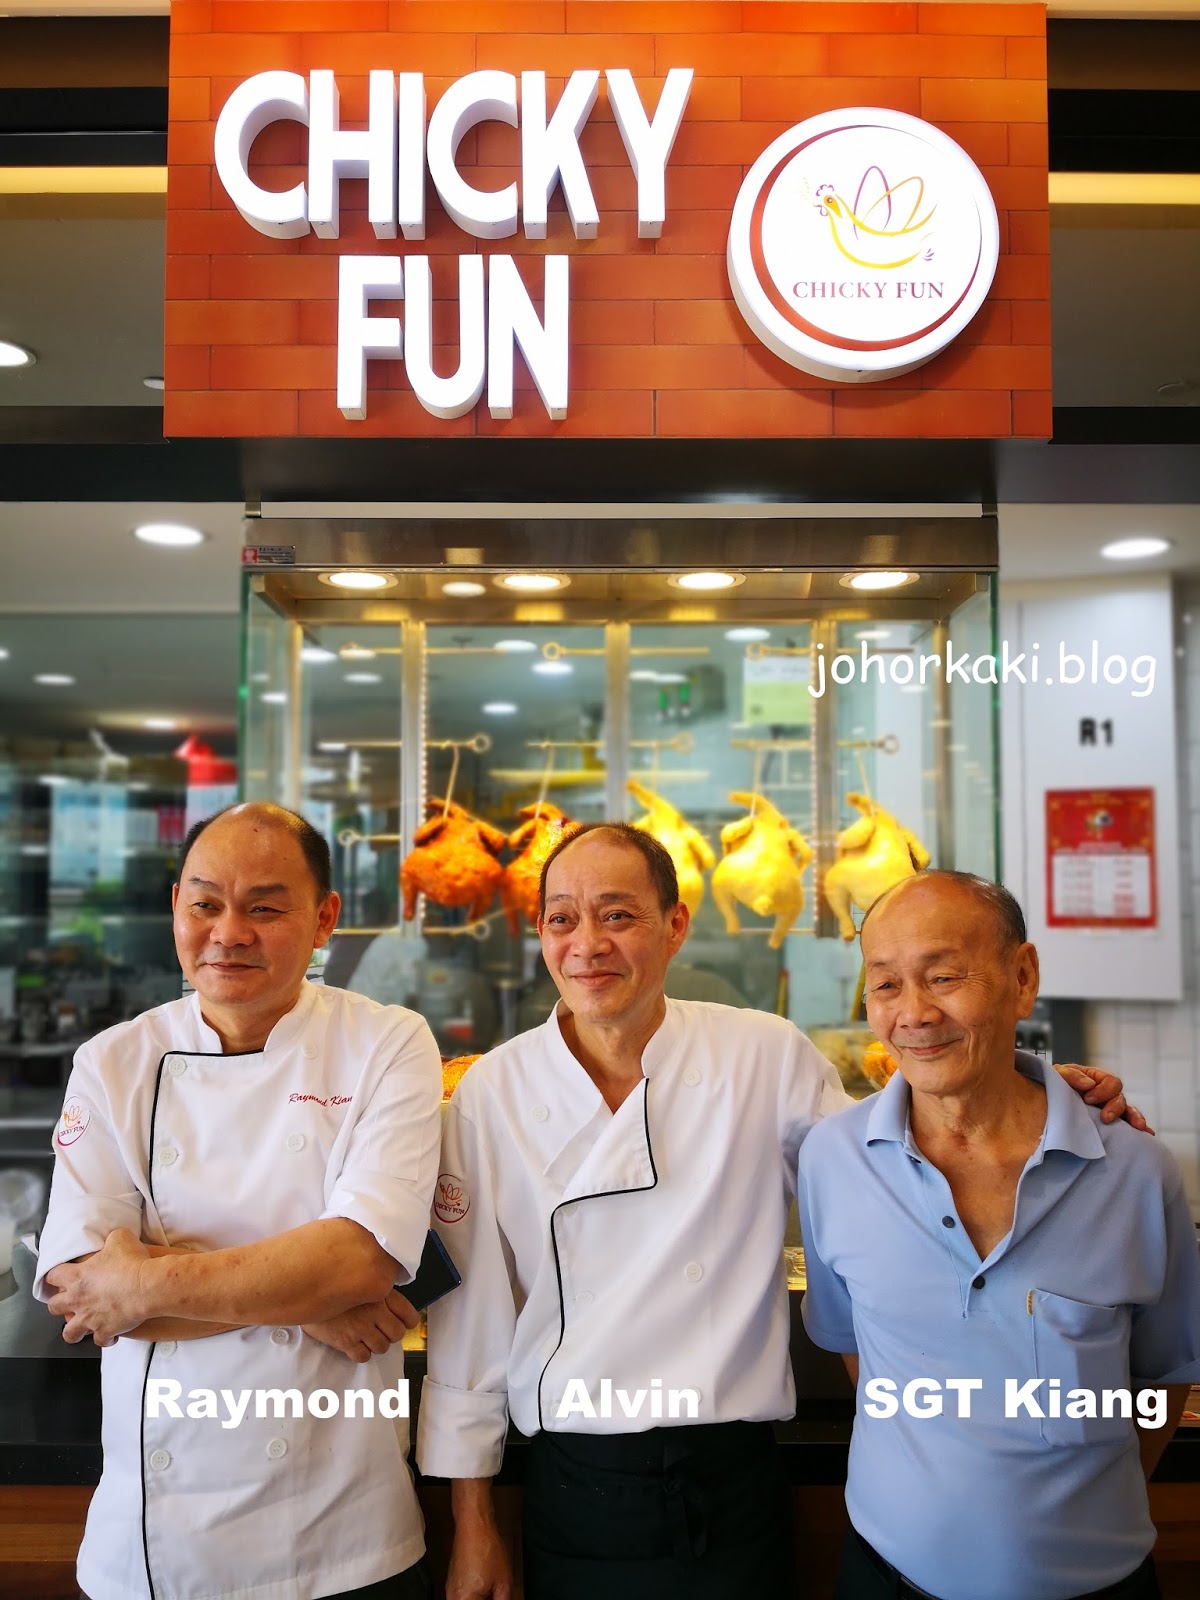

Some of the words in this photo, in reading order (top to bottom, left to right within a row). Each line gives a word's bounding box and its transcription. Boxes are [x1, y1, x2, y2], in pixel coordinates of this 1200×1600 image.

[213, 68, 695, 240] CHICKY
[792, 281, 888, 299] CHICKY
[895, 281, 945, 299] FUN
[336, 254, 570, 420] FUN
[1079, 717, 1113, 746] R1
[330, 1095, 353, 1107] Kian
